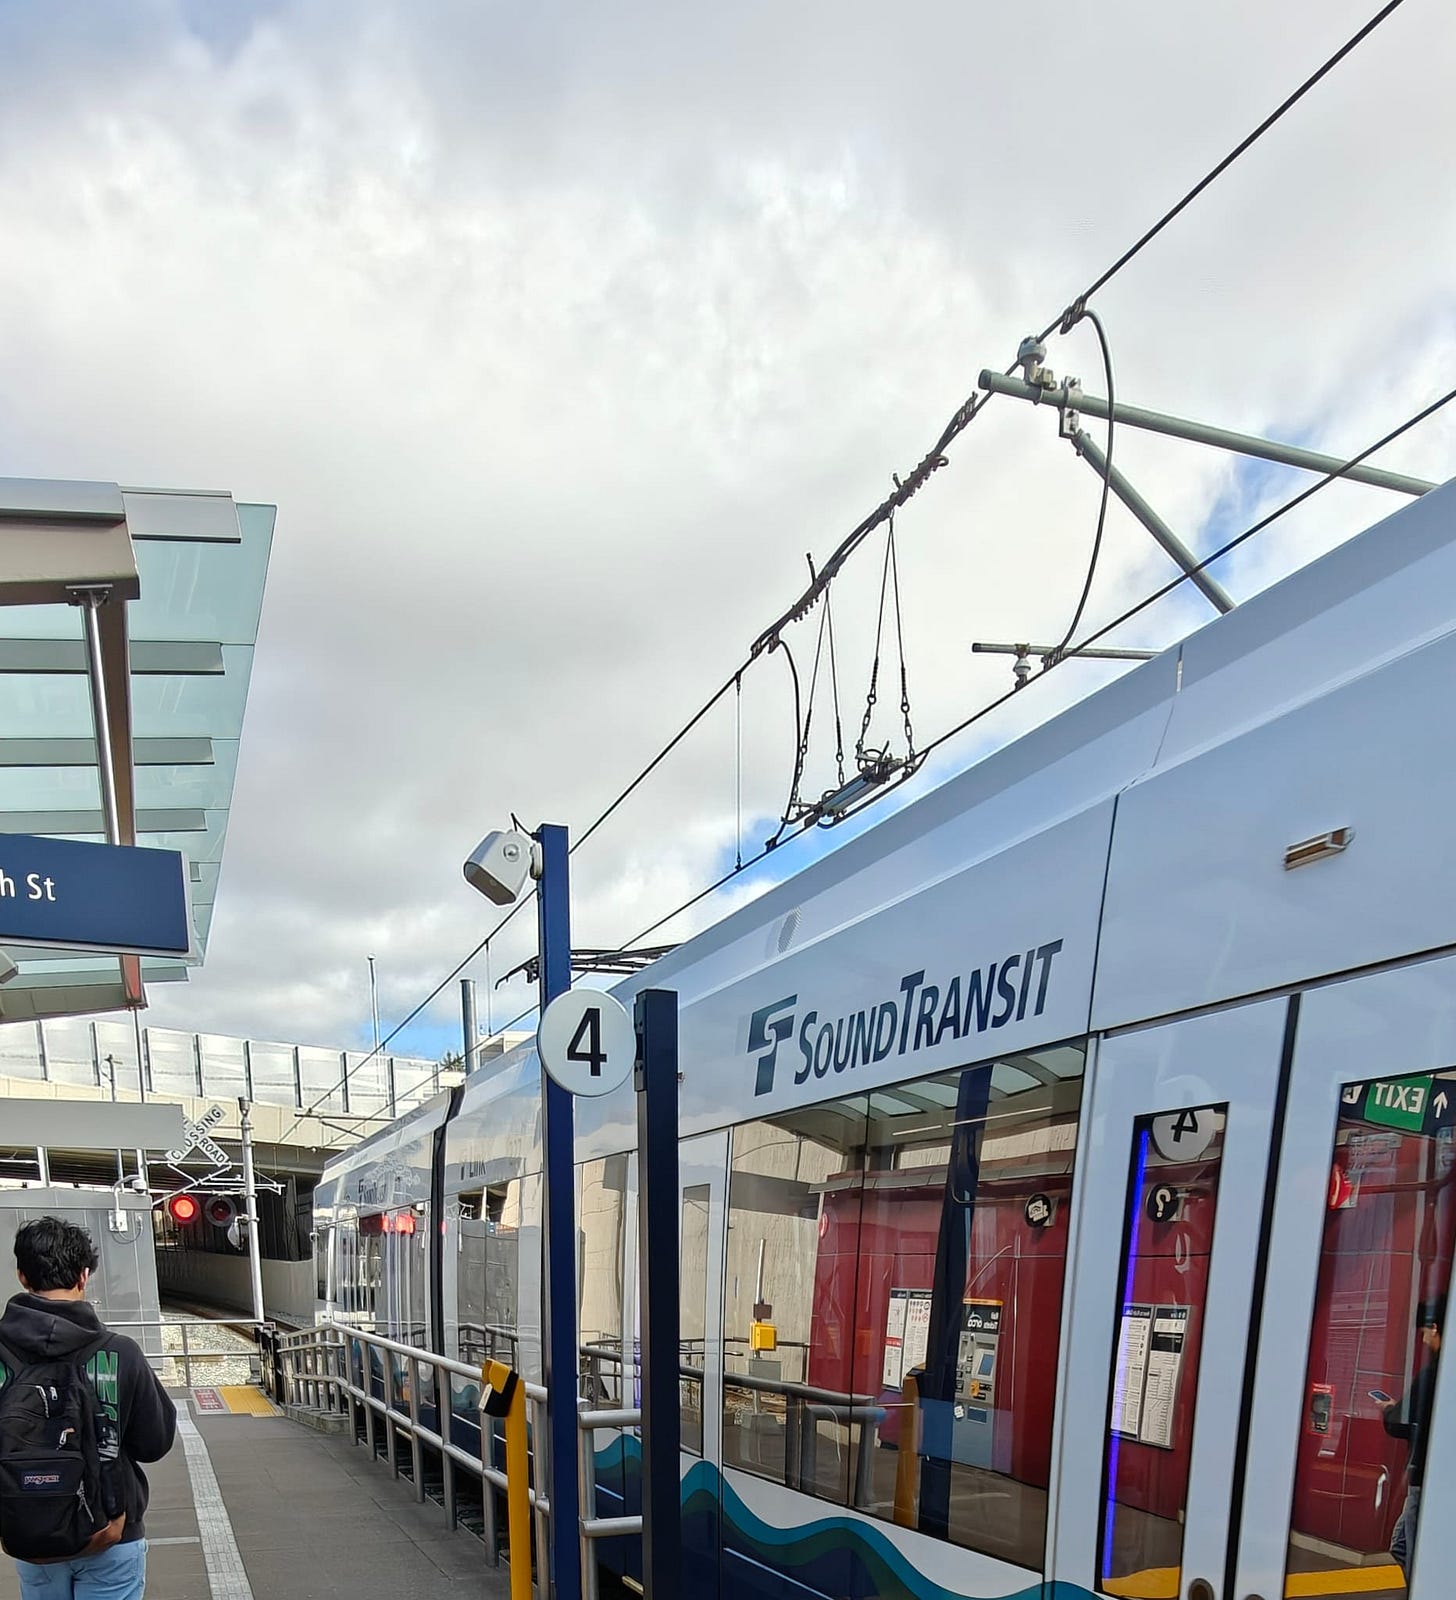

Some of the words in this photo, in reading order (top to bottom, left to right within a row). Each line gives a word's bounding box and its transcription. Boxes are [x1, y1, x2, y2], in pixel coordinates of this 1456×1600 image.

[26, 873, 56, 902] St
[567, 1007, 607, 1077] 4
[170, 1109, 222, 1161] COSSING
[198, 1137, 226, 1163] ROAD
